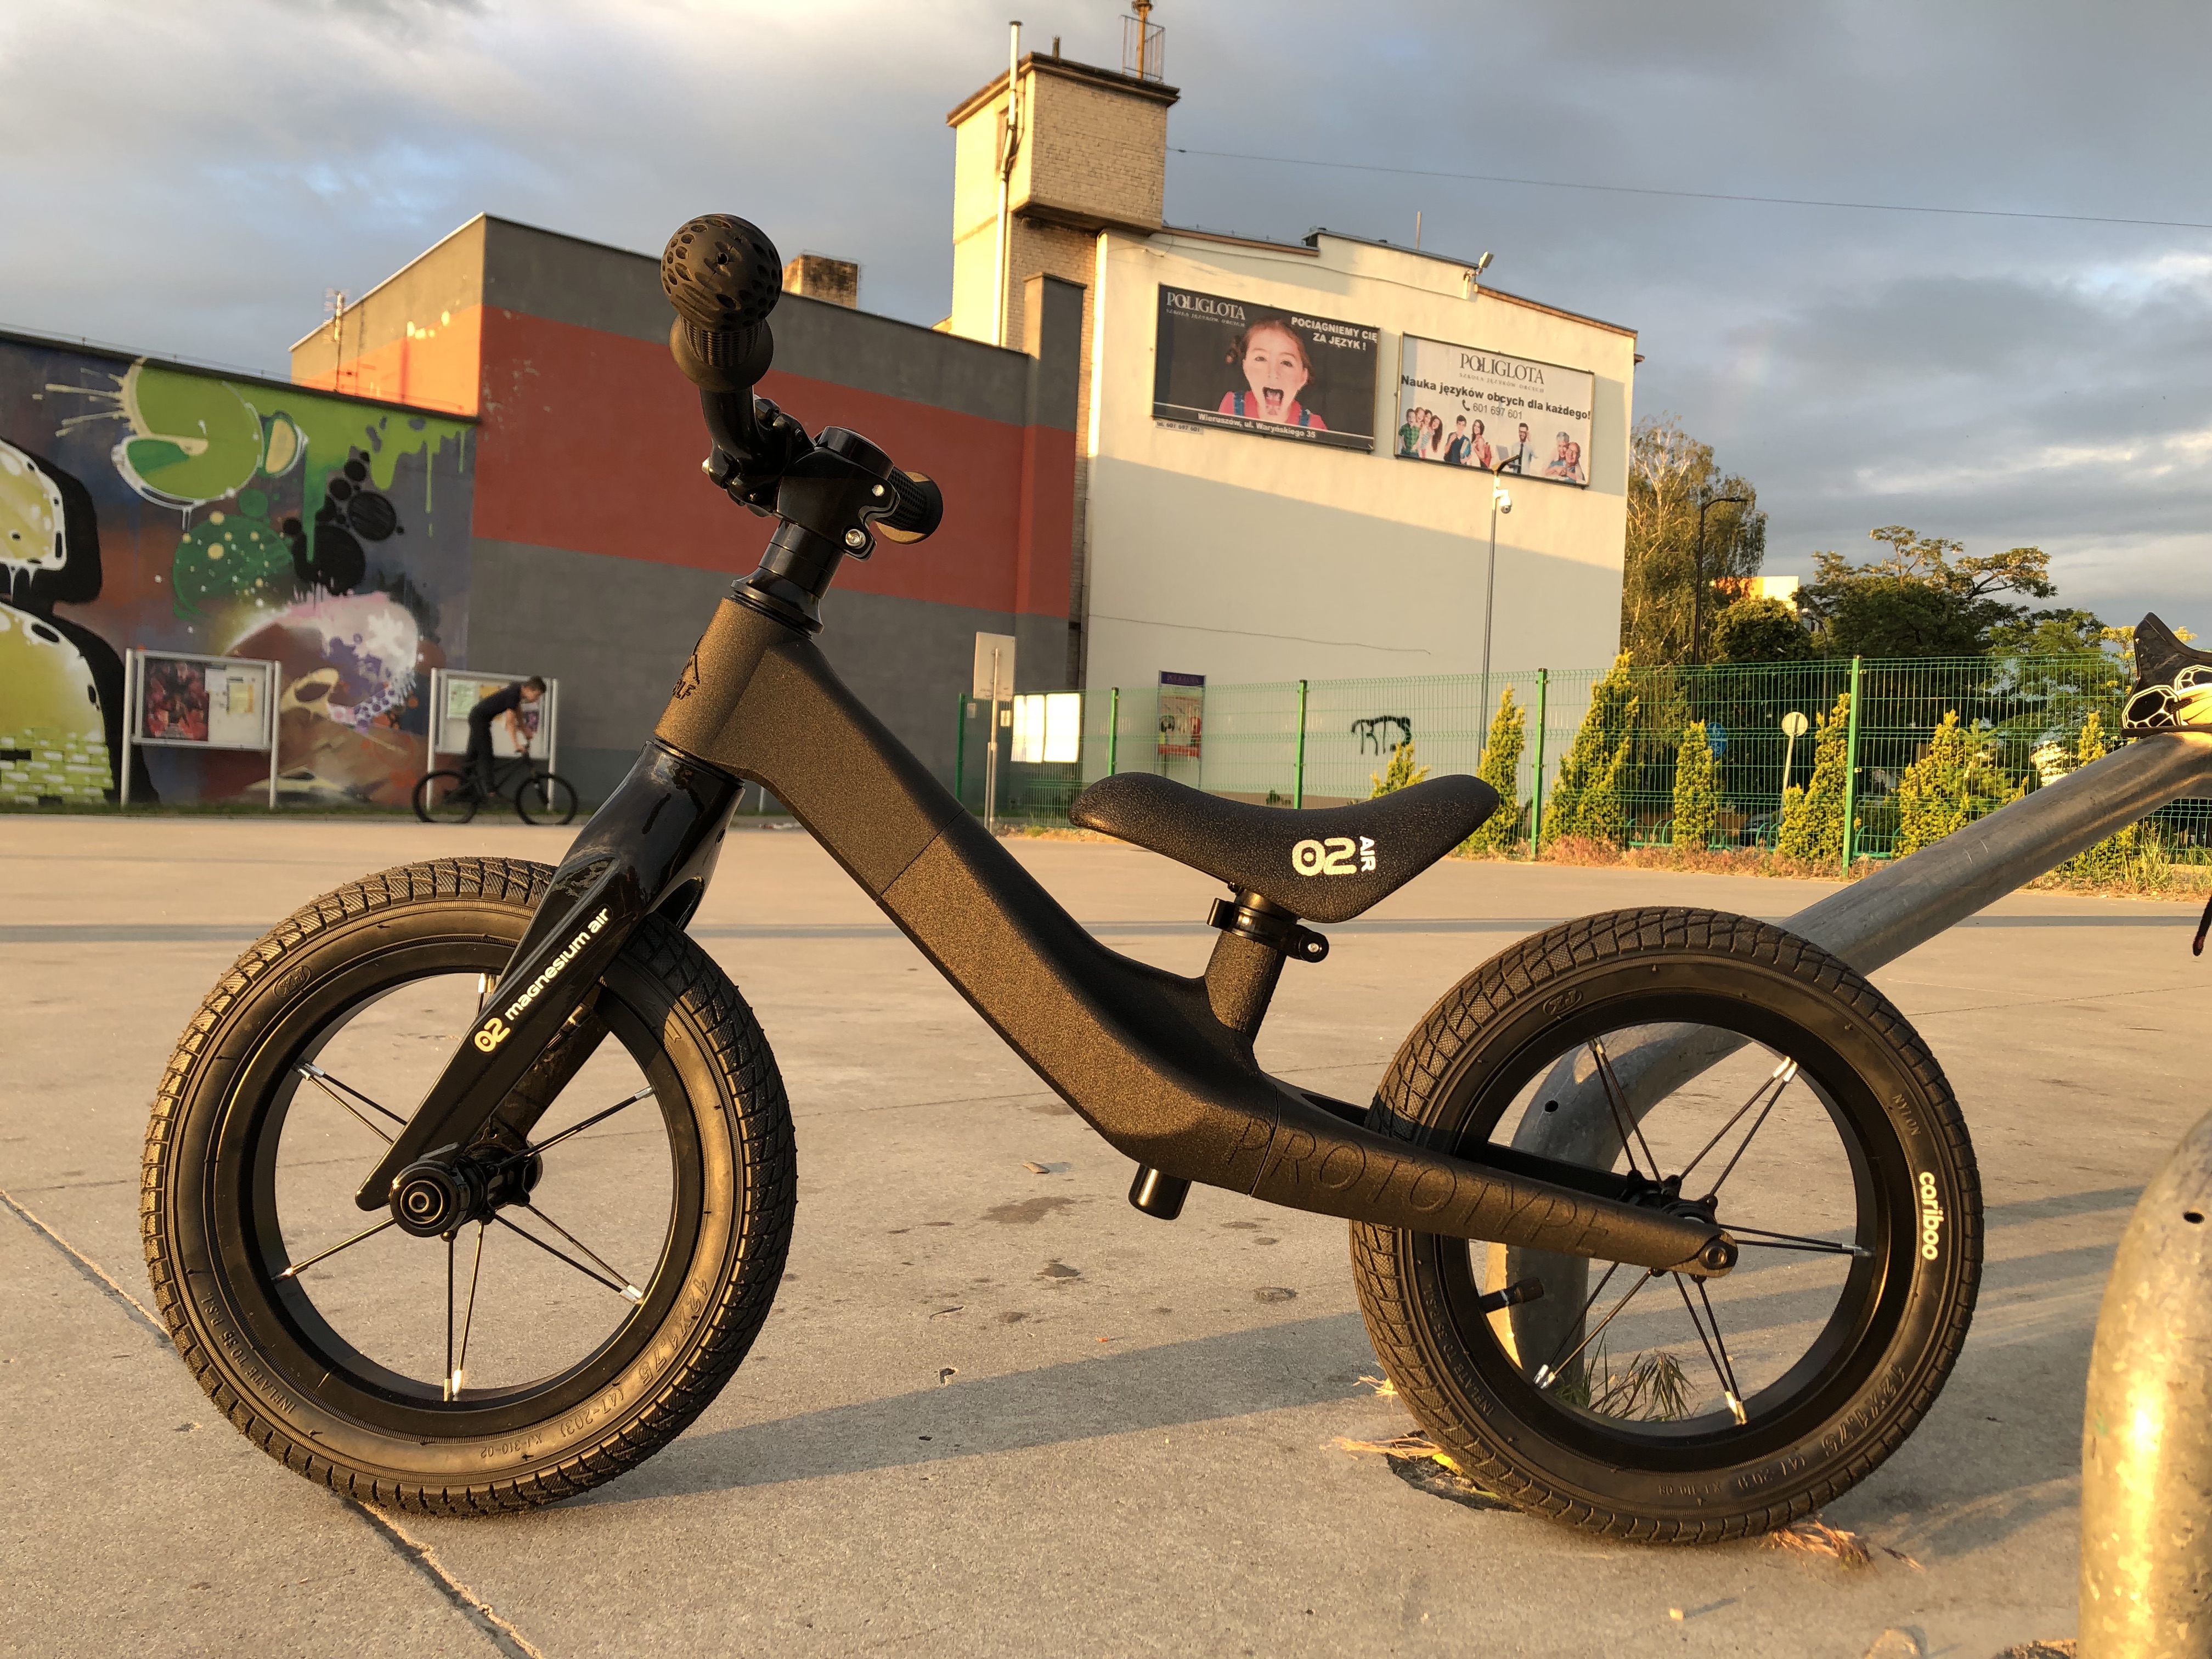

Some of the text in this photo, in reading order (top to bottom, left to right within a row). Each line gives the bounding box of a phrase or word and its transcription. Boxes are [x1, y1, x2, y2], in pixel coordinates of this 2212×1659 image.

[1166, 292, 1245, 320] POLIGLOTA
[1291, 316, 1378, 343] POCIĄGNIEMY CIĘ
[1313, 332, 1327, 343] ZA
[1459, 353, 1545, 385] POLIGLOTA
[1401, 374, 1591, 420] Nauka języków obcych dla każdego!
[1472, 402, 1522, 420] 601 697 601
[1198, 413, 1242, 427] Wieruszów,
[1255, 422, 1305, 437] Waryńskiego
[1306, 430, 1316, 438] 35
[1359, 835, 1377, 873] AIR
[504, 931, 591, 1021] magnesium
[587, 907, 609, 934] air
[1893, 1093, 1921, 1136] NYLON
[1227, 1115, 1609, 1255] PROTOTYPE
[1919, 1171, 1944, 1261] cariboo
[230, 1348, 249, 1368] TO
[246, 1365, 297, 1415] INFLATE
